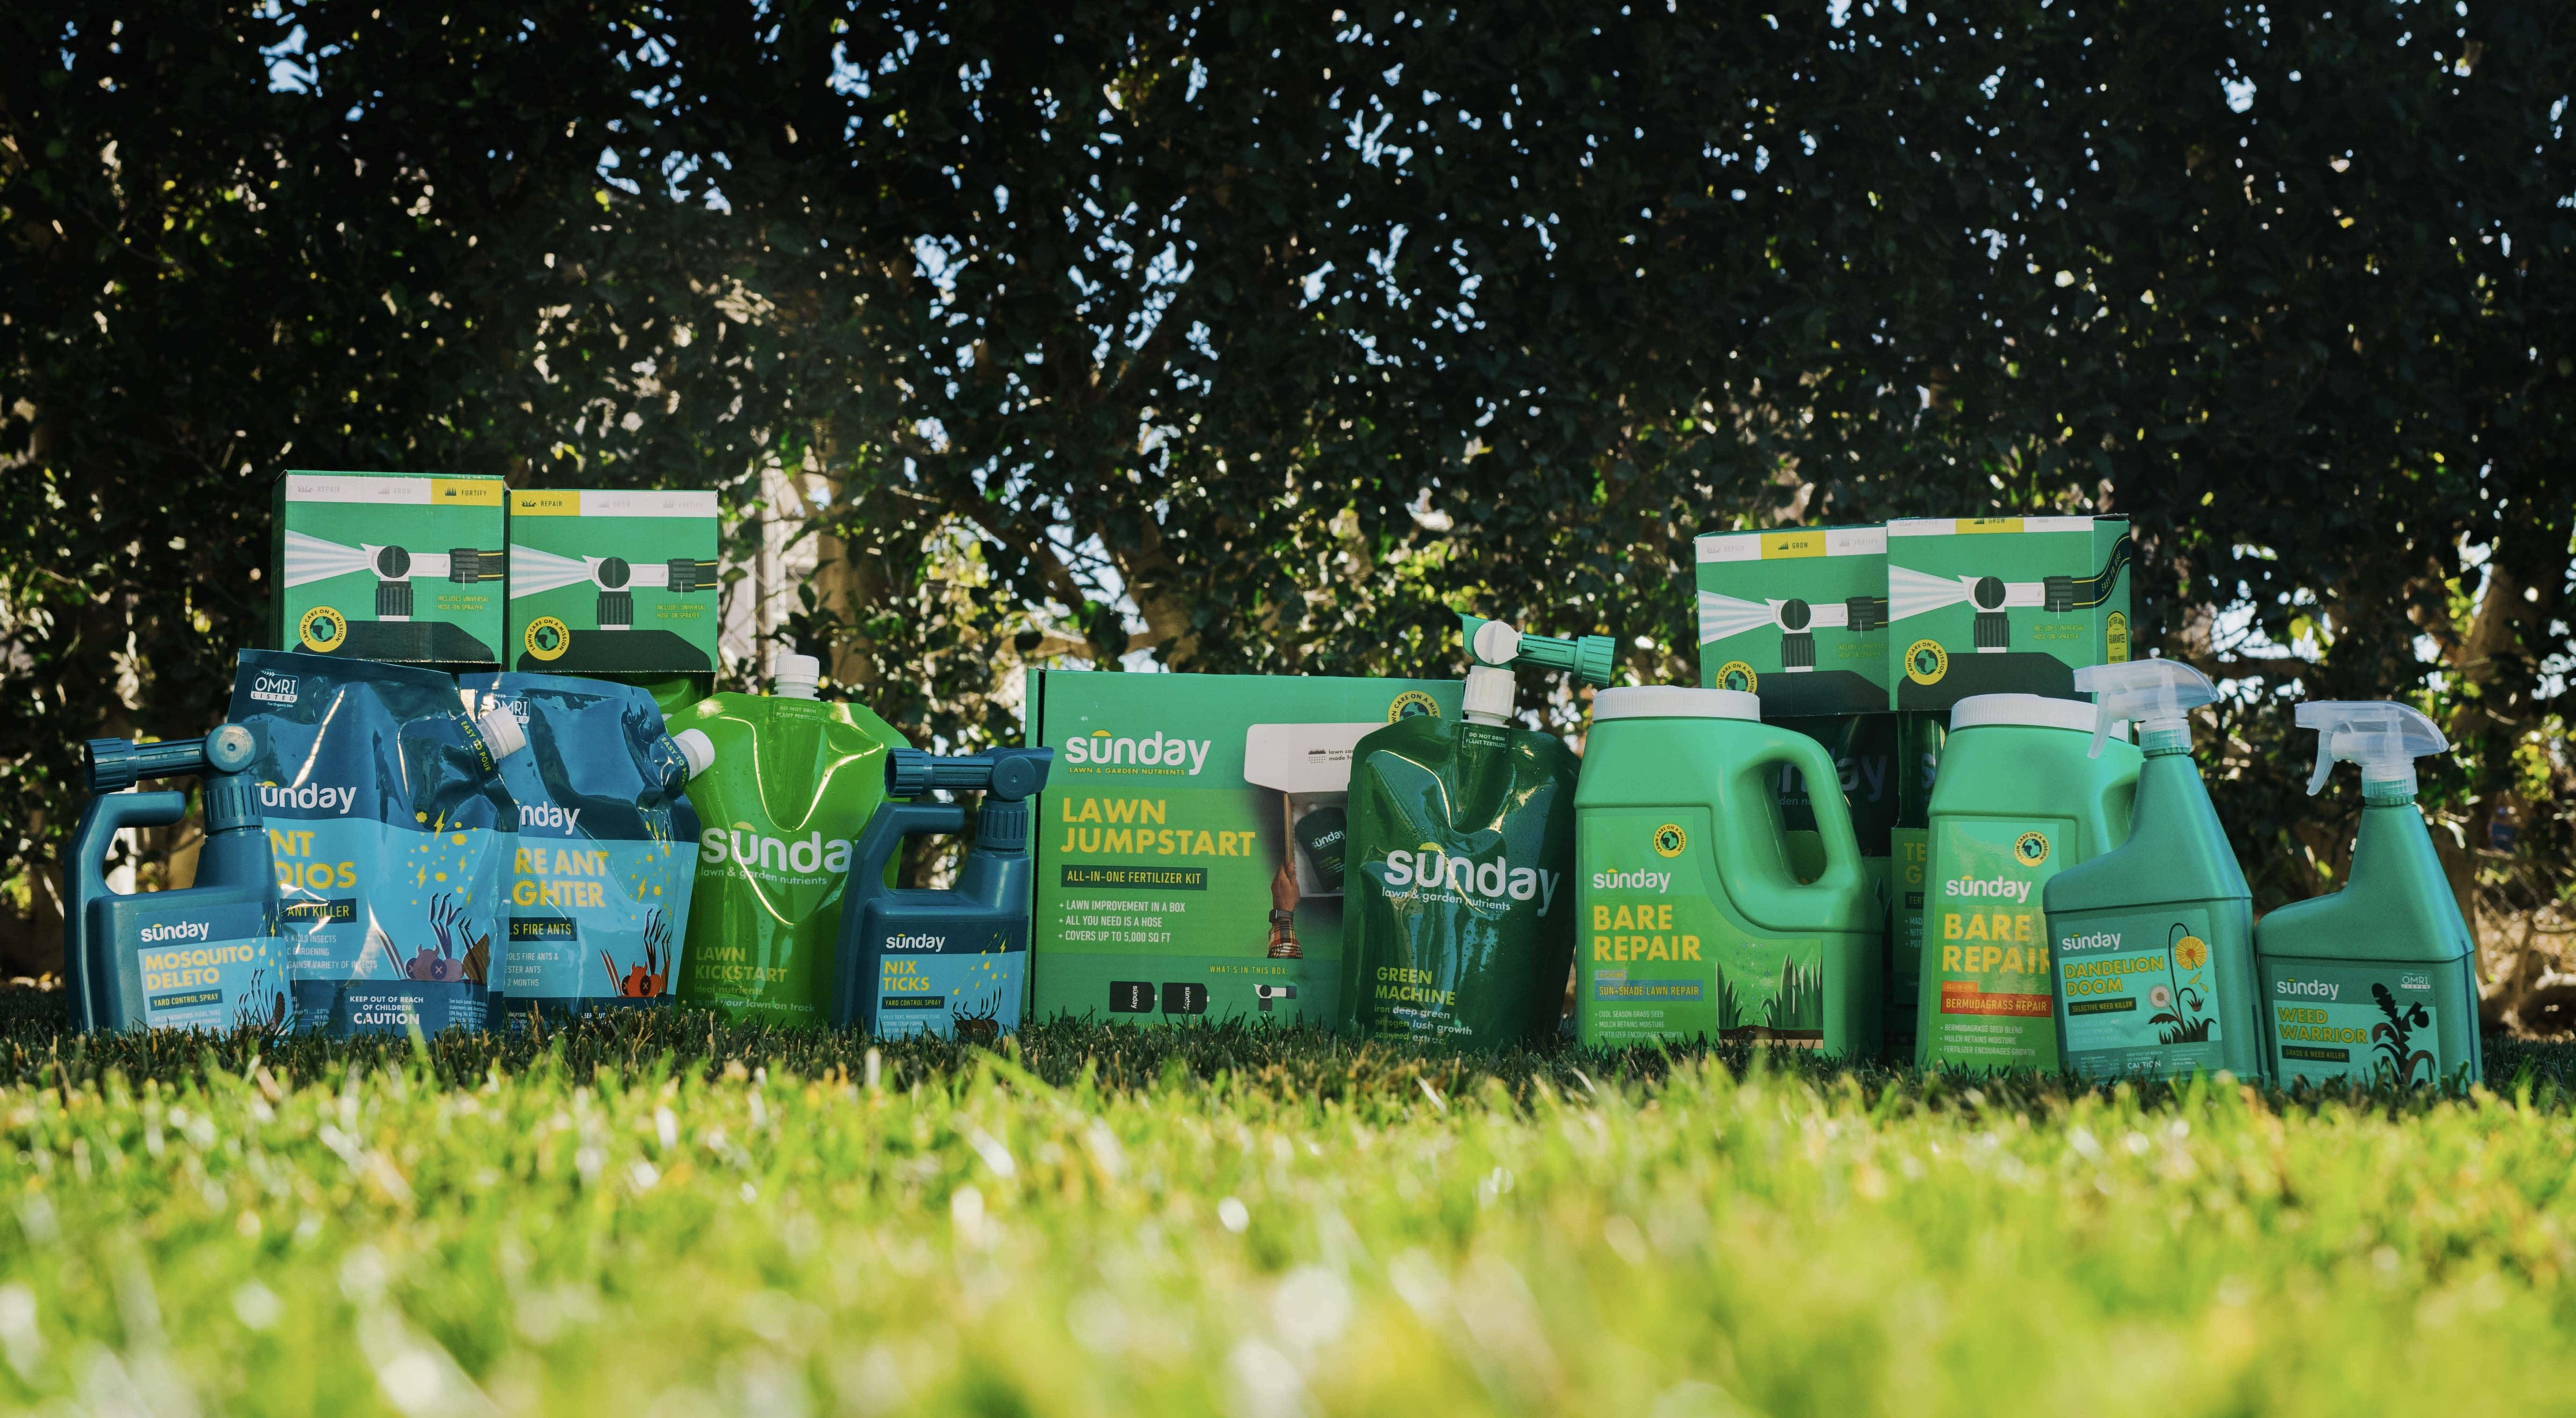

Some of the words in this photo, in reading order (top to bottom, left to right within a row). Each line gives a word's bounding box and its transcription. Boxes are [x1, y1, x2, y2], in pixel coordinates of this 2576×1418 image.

[306, 610, 318, 622] CARE
[530, 621, 543, 632] CARE
[527, 633, 536, 651] LAWN
[255, 677, 296, 694] OMRI
[1065, 731, 1211, 775] sunday
[260, 783, 357, 814] unday
[520, 801, 580, 836] nday
[1063, 798, 1165, 824] LAWN
[702, 828, 858, 874] sunda
[1060, 828, 1256, 857] JUMPSTART
[275, 860, 357, 889] DIOS
[702, 866, 724, 876] lawn
[727, 867, 735, 876] &
[739, 868, 777, 883] garden
[780, 875, 827, 885] nutrients
[1067, 870, 1125, 883] ALL-IN-ONE
[1128, 871, 1182, 884] FERTILIZER
[1186, 873, 1201, 885] KIT
[1384, 847, 1560, 917] sunday
[1593, 868, 1671, 894] sunday
[512, 880, 607, 908] GHTER
[1946, 876, 2032, 903] sunday
[1067, 900, 1090, 910] LAWN
[1091, 901, 1149, 912] IMPROVEMENT
[1151, 902, 1159, 912] IN
[1161, 903, 1167, 912] A
[1170, 903, 1186, 913] BOX
[1382, 887, 1410, 899] lawn
[1412, 890, 1420, 899] &
[1422, 891, 1463, 904] garden
[1465, 897, 1511, 911] nutrients
[287, 906, 308, 917] ANT
[312, 906, 350, 918] KILLER
[1066, 915, 1080, 926] ALL
[1083, 916, 1098, 926] YOU
[1101, 916, 1121, 926] NEED
[1124, 917, 1132, 926] IS
[1134, 917, 1140, 926] A
[1142, 918, 1162, 927] HOSE
[1593, 904, 1673, 931] BARE
[140, 920, 210, 943] sunday
[523, 924, 544, 935] FIRE
[547, 924, 571, 935] ANTS
[1944, 913, 2031, 942] BARE
[886, 933, 946, 952] sunday
[1065, 931, 1096, 940] COVERS
[1098, 932, 1109, 941] UP
[1111, 932, 1121, 941] TO
[1124, 932, 1146, 942] 5,000
[1148, 933, 1159, 942] SQ
[1161, 933, 1171, 943] FT
[2062, 932, 2121, 951] sunday
[696, 947, 746, 962] LAWN
[1594, 935, 1702, 962] REPAIR
[144, 945, 254, 972] MOSQUITO
[884, 960, 917, 975] NIX
[2064, 955, 2164, 979] DANDELION
[695, 964, 787, 983] KICKSTART
[1209, 965, 1238, 974] WHAT'S
[1272, 966, 1288, 975] BOX:
[1377, 967, 1433, 985] GREEN
[146, 968, 220, 991] DELETO
[883, 976, 930, 992] TICKS
[2066, 977, 2123, 996] DOOM
[2402, 976, 2429, 985] OMRI
[719, 987, 764, 995] nutrients
[1375, 985, 1456, 1006] MACHINE
[1646, 986, 1668, 996] LAWN
[1670, 986, 1699, 996] REPAIR
[2277, 980, 2340, 1000] sunday
[154, 997, 169, 1007] YARD
[171, 995, 198, 1006] CONTROL
[199, 992, 219, 1003] SPRAY
[721, 999, 744, 1008] your
[746, 998, 771, 1009] lawn
[774, 1002, 787, 1011] on
[790, 1002, 815, 1012] track
[1946, 998, 2013, 1010] BERMUDAGRASS
[2016, 999, 2047, 1012] REPAIR
[2072, 1004, 2098, 1012] SELECTIVE
[2099, 1002, 2114, 1011] WEED
[2115, 1000, 2133, 1009] KILLER
[353, 1013, 420, 1025] CAUTION
[1375, 1004, 1390, 1014] iron
[1393, 1006, 1417, 1017] deep
[1420, 1009, 1450, 1020] green
[2277, 1007, 2327, 1024] WEED
[1375, 1018, 1410, 1029] nitrogen
[1412, 1020, 1434, 1030] lush
[1437, 1023, 1472, 1036] growth
[1945, 1024, 1988, 1033] BERMUDAGRASS
[2279, 1025, 2368, 1044] WARRIOR
[2285, 1048, 2303, 1057] GRASS
[2310, 1050, 2325, 1058] WEED
[2326, 1051, 2345, 1059] KILLER
